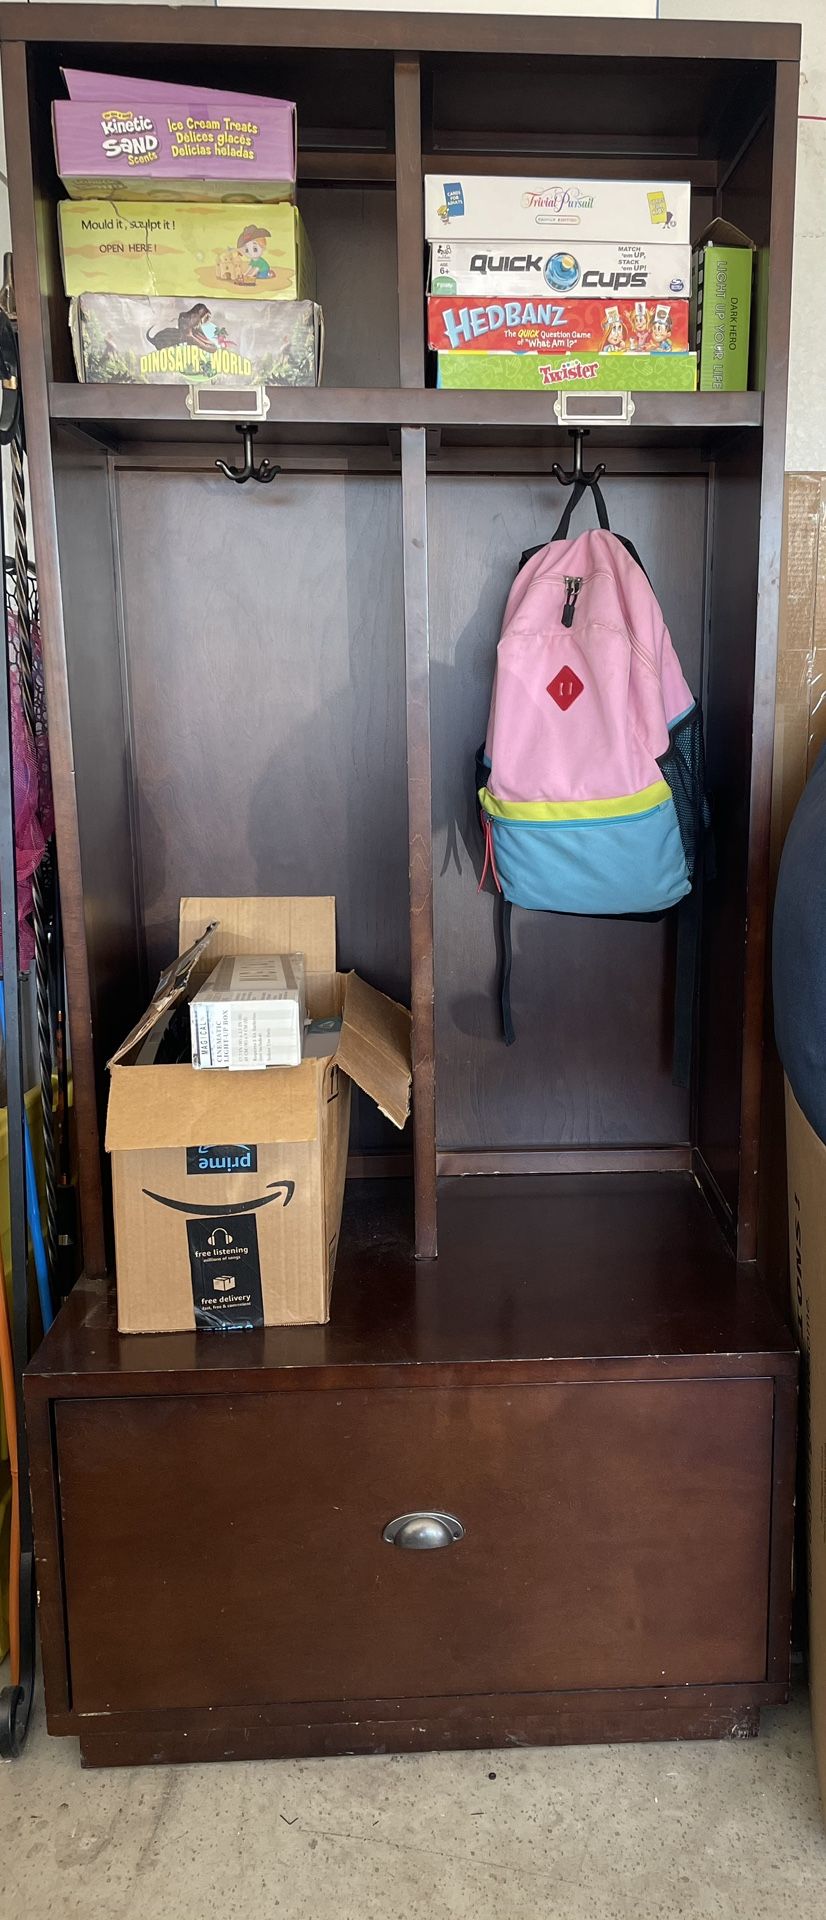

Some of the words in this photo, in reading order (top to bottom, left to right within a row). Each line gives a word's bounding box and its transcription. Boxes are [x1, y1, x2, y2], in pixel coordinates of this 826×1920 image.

[101, 116, 152, 135] Kinetic
[168, 118, 184, 132] Ice
[186, 117, 220, 130] Cream
[224, 117, 258, 134] Treats
[128, 151, 158, 166] Scents
[171, 145, 212, 157] Delicias
[214, 144, 255, 160] heladas
[521, 189, 557, 208] Trivial
[554, 187, 594, 212] Pursuit
[81, 219, 114, 230] Mould
[99, 244, 124, 253] OPEN
[715, 261, 727, 299] LIGHT
[714, 304, 726, 320] UP
[730, 297, 738, 324] DARK
[442, 302, 568, 349] HEDBANZ
[518, 329, 539, 338] QUICK
[540, 330, 570, 338] Question
[713, 324, 726, 360] YOUR
[729, 326, 737, 350] HERO
[211, 349, 252, 376] WORLD
[539, 361, 599, 384] Twister
[711, 366, 723, 389] LIFE
[198, 1153, 251, 1172] prime
[213, 1247, 248, 1256] listening
[219, 1294, 251, 1304] delivery
